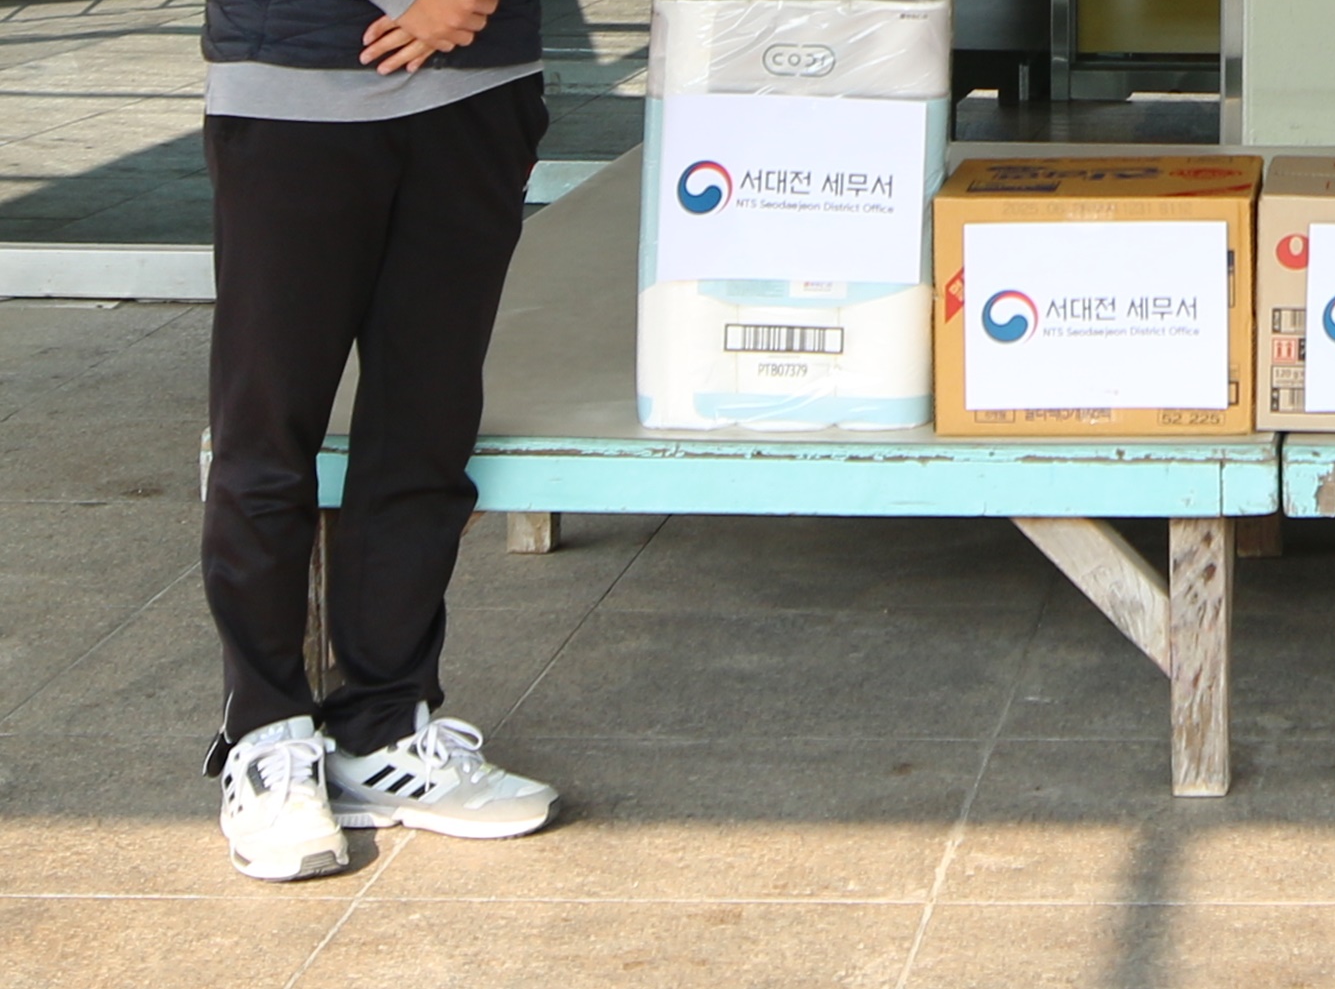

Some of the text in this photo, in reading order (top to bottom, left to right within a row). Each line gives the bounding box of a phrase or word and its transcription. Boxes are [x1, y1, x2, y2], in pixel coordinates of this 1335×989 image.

[740, 170, 893, 198] 서대전 세무서
[736, 199, 757, 208] NTS
[824, 202, 860, 212] District
[863, 204, 894, 213] Office
[1046, 297, 1197, 321] 서대전 세무서
[1043, 328, 1063, 337] NTS
[1130, 326, 1165, 336] District
[1169, 327, 1200, 336] Office
